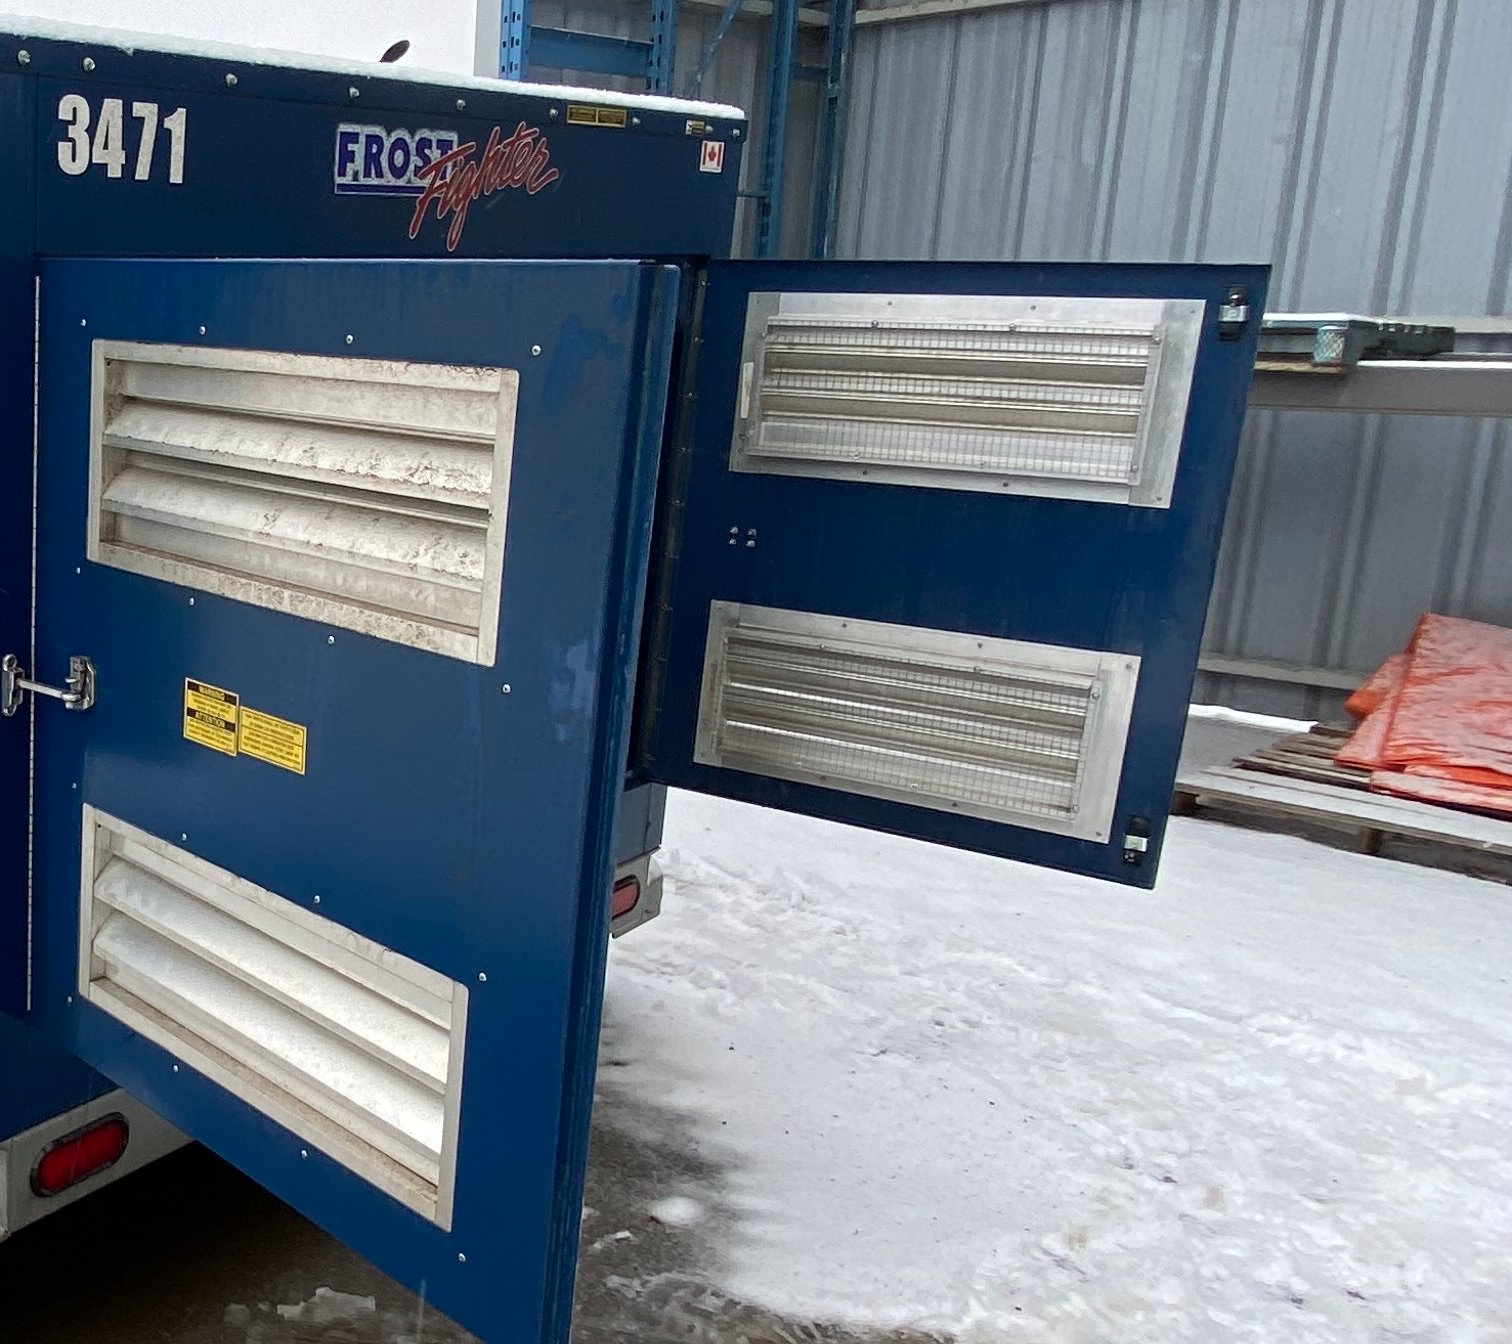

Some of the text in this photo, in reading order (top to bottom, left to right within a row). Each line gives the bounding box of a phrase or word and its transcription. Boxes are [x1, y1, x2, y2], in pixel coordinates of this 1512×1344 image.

[56, 93, 187, 185] 3471
[337, 131, 454, 181] FROST
[408, 121, 559, 252] Fighter
